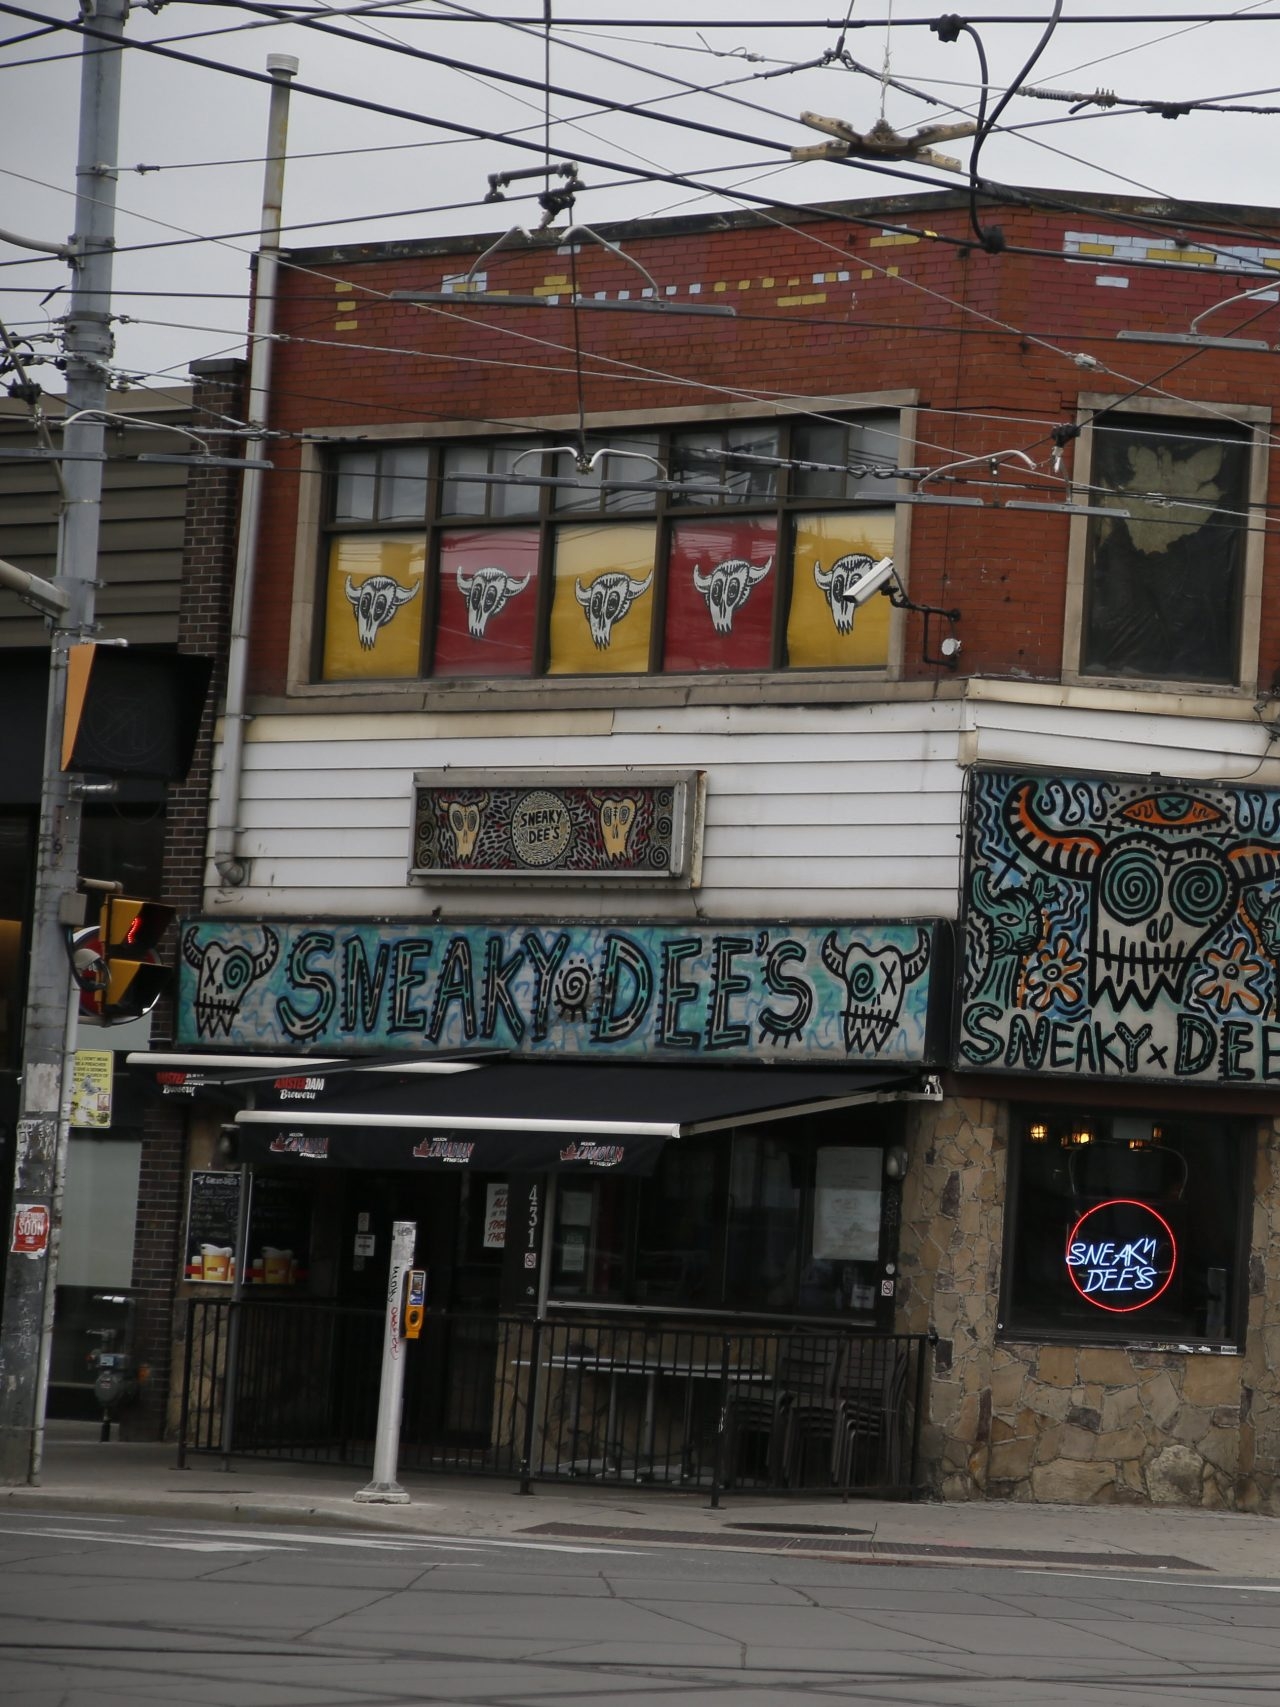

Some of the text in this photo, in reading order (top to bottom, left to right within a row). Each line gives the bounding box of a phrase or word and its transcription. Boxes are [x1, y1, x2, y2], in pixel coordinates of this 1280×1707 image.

[520, 809, 562, 828] SNEAKY
[529, 825, 560, 844] DEE'S
[275, 930, 814, 1050] SNEAKY DEE'S
[960, 1001, 1153, 1075] SNEAKY
[280, 1089, 316, 1100] Brewery
[18, 1217, 44, 1236] SOON
[1066, 1237, 1156, 1267] SNEAKY
